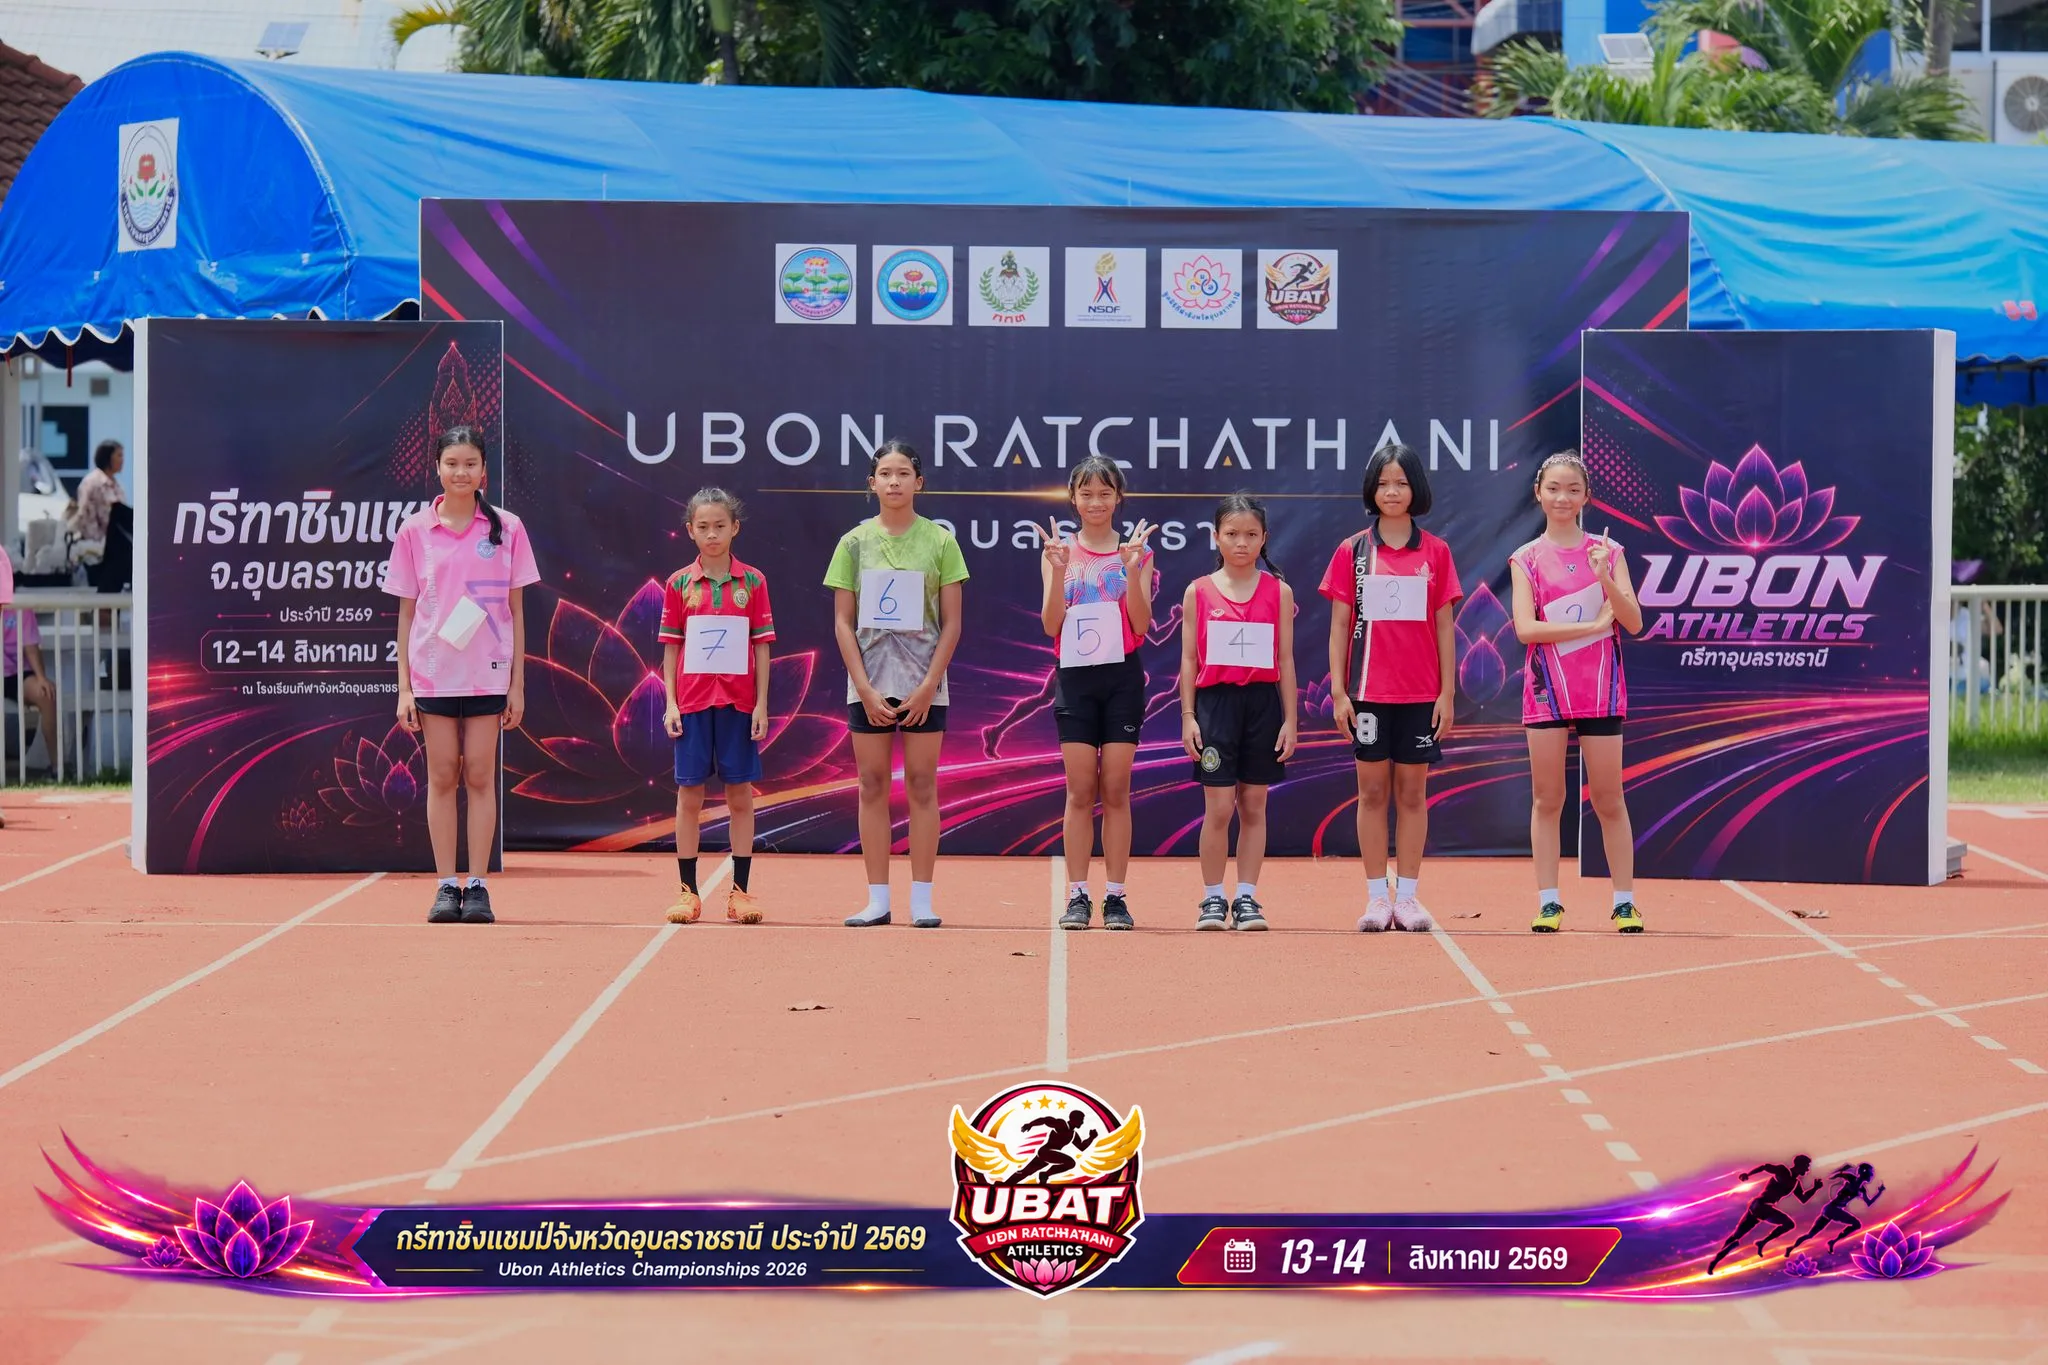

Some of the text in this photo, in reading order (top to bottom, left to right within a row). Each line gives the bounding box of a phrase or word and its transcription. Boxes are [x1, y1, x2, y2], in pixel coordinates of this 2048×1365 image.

[1088, 305, 1121, 314] NSDF
[1271, 290, 1326, 304] UBAT
[627, 411, 1499, 471] UBON RATCHATHANI
[173, 488, 430, 544] กรีฑาชิงแช
[879, 578, 897, 614] 6
[1638, 554, 1889, 609] UBON
[1385, 580, 1401, 614] 3
[280, 606, 373, 623] ประจำปี 2569
[1643, 612, 1872, 641] ATHLETICS
[212, 640, 285, 664] 12–14
[294, 639, 377, 663] สิงหาคม
[700, 629, 727, 660] 7
[1077, 618, 1101, 656] 5
[1228, 628, 1257, 658] 4
[1681, 646, 1829, 671] กรีฑาอุบลราชธานี
[242, 681, 398, 697] ณ โรงเรียนกีฬาจังหวัดอุบลราชธ
[1356, 712, 1378, 744] 8
